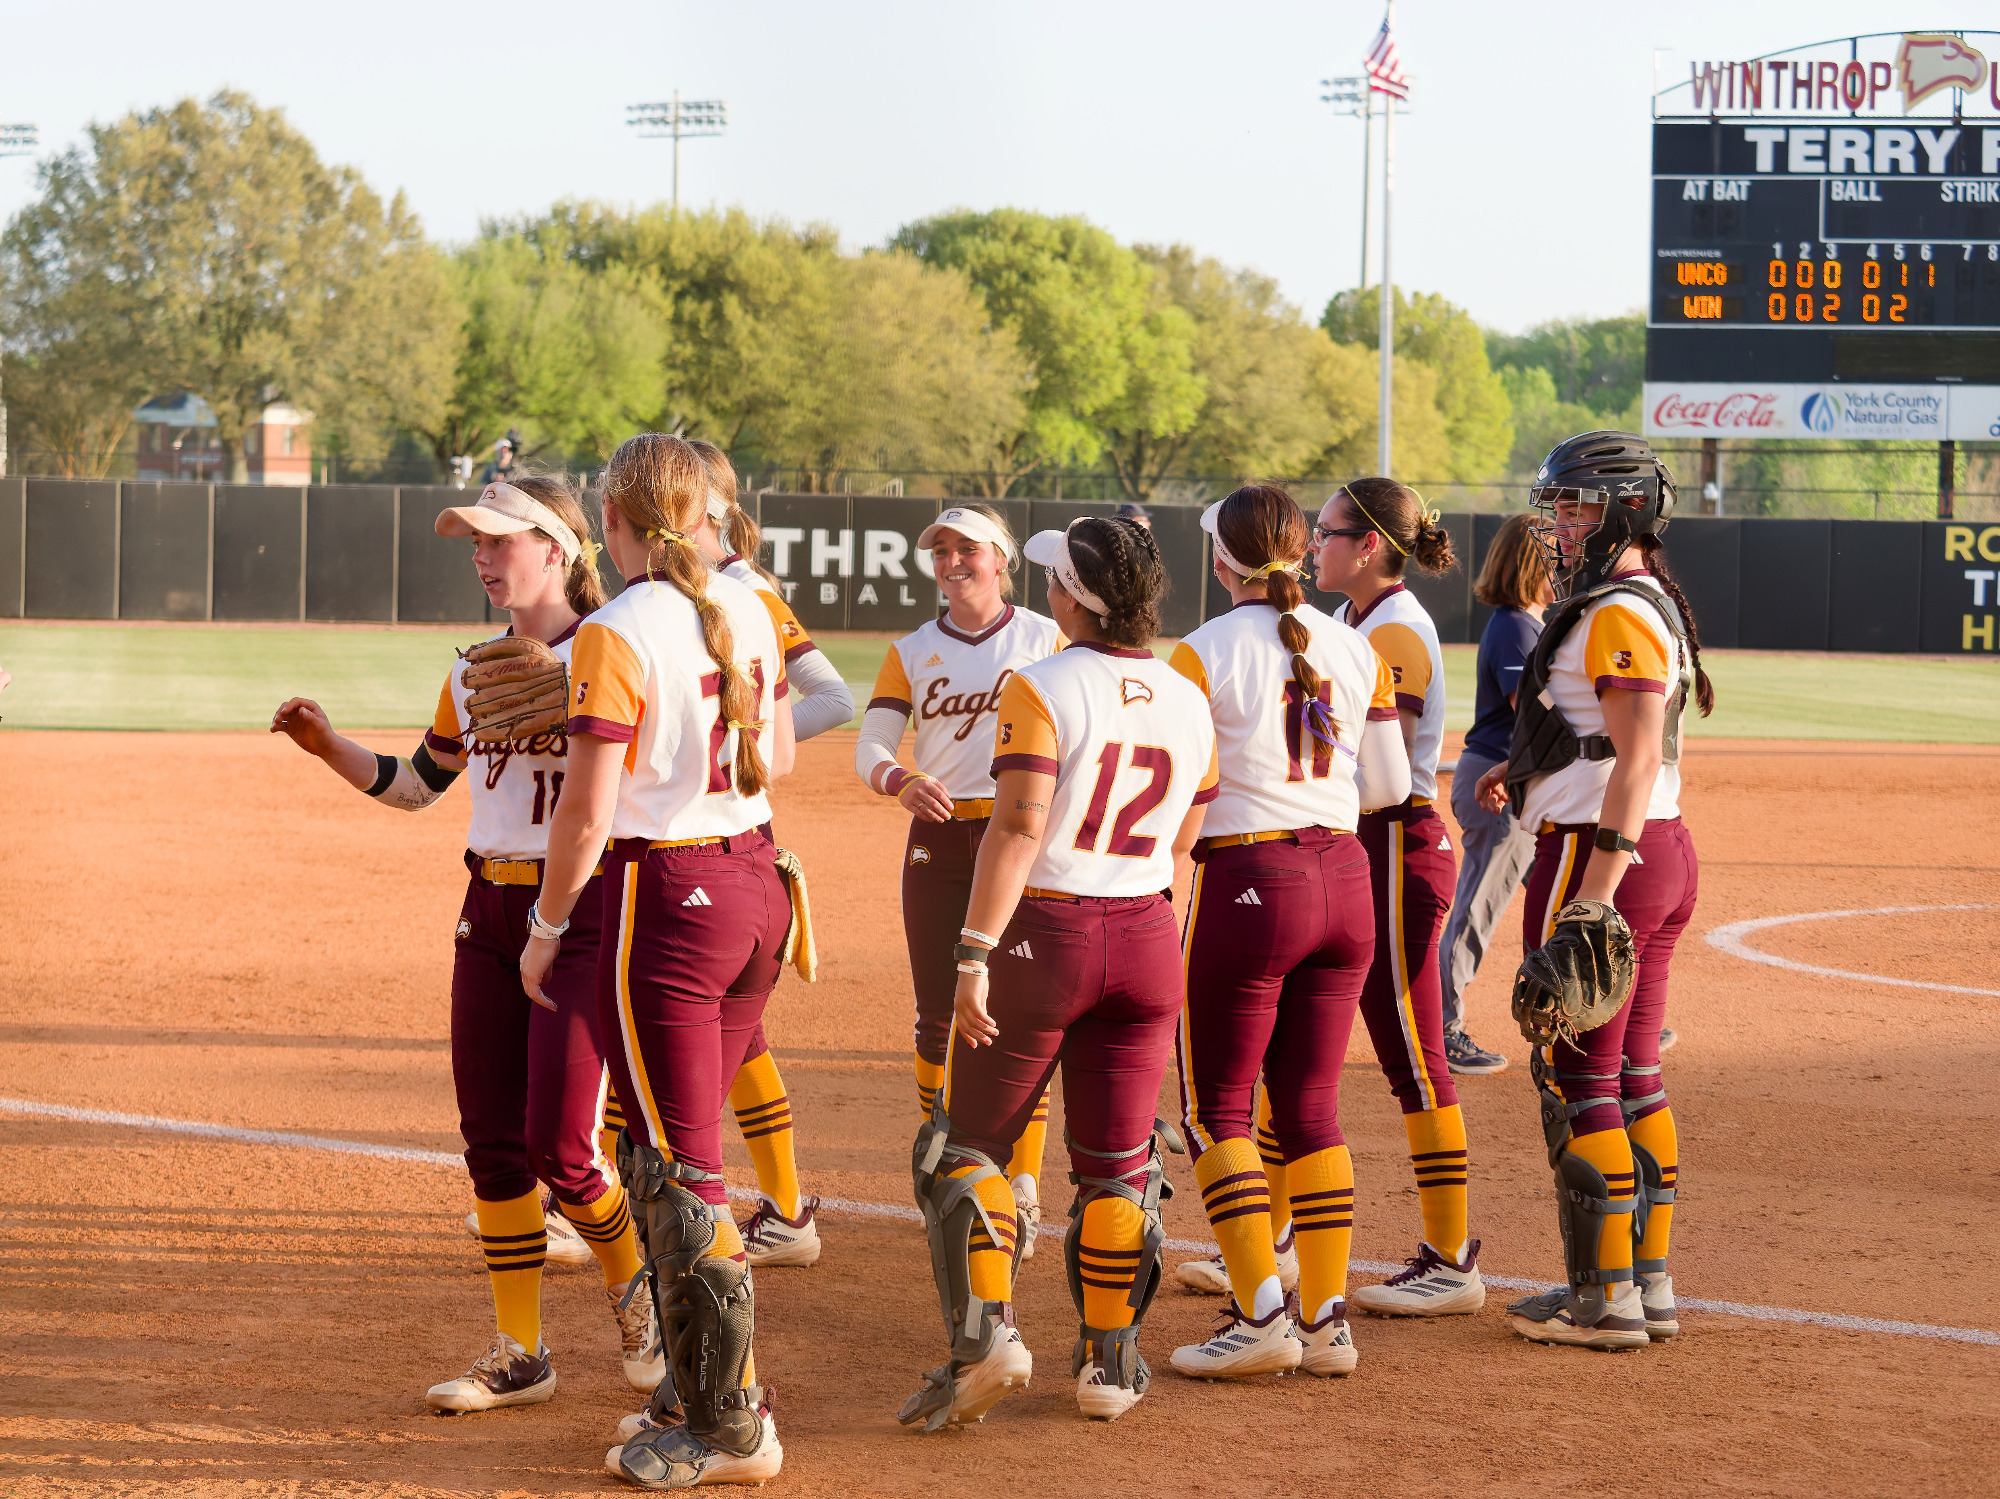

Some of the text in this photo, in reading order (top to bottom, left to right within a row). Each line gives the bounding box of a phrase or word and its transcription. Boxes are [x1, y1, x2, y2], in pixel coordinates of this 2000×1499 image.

[1690, 61, 1891, 110] WINTHROP
[1744, 128, 1961, 173] TERRY
[1683, 181, 1751, 201] AT BAT
[1831, 181, 1882, 201] BALL
[1941, 181, 2000, 203] STRIK
[1772, 242, 1999, 261] 1 2 3 4 5 6 7 8
[1768, 260, 1787, 288] 0
[1796, 260, 1814, 289] 0
[1823, 260, 1842, 289] 0
[1862, 261, 1881, 289] 0
[1901, 263, 1908, 287] 1
[1928, 263, 1935, 287] 1
[1683, 293, 1908, 322] WIN 0 0 2 0 2
[1653, 393, 1778, 429] Coca-Cola
[1844, 392, 1942, 413] York County
[1845, 409, 1938, 426] Natural Gas
[1600, 535, 1632, 576] SAMURAI
[1964, 569, 2000, 607] T
[1072, 740, 1174, 860] 12
